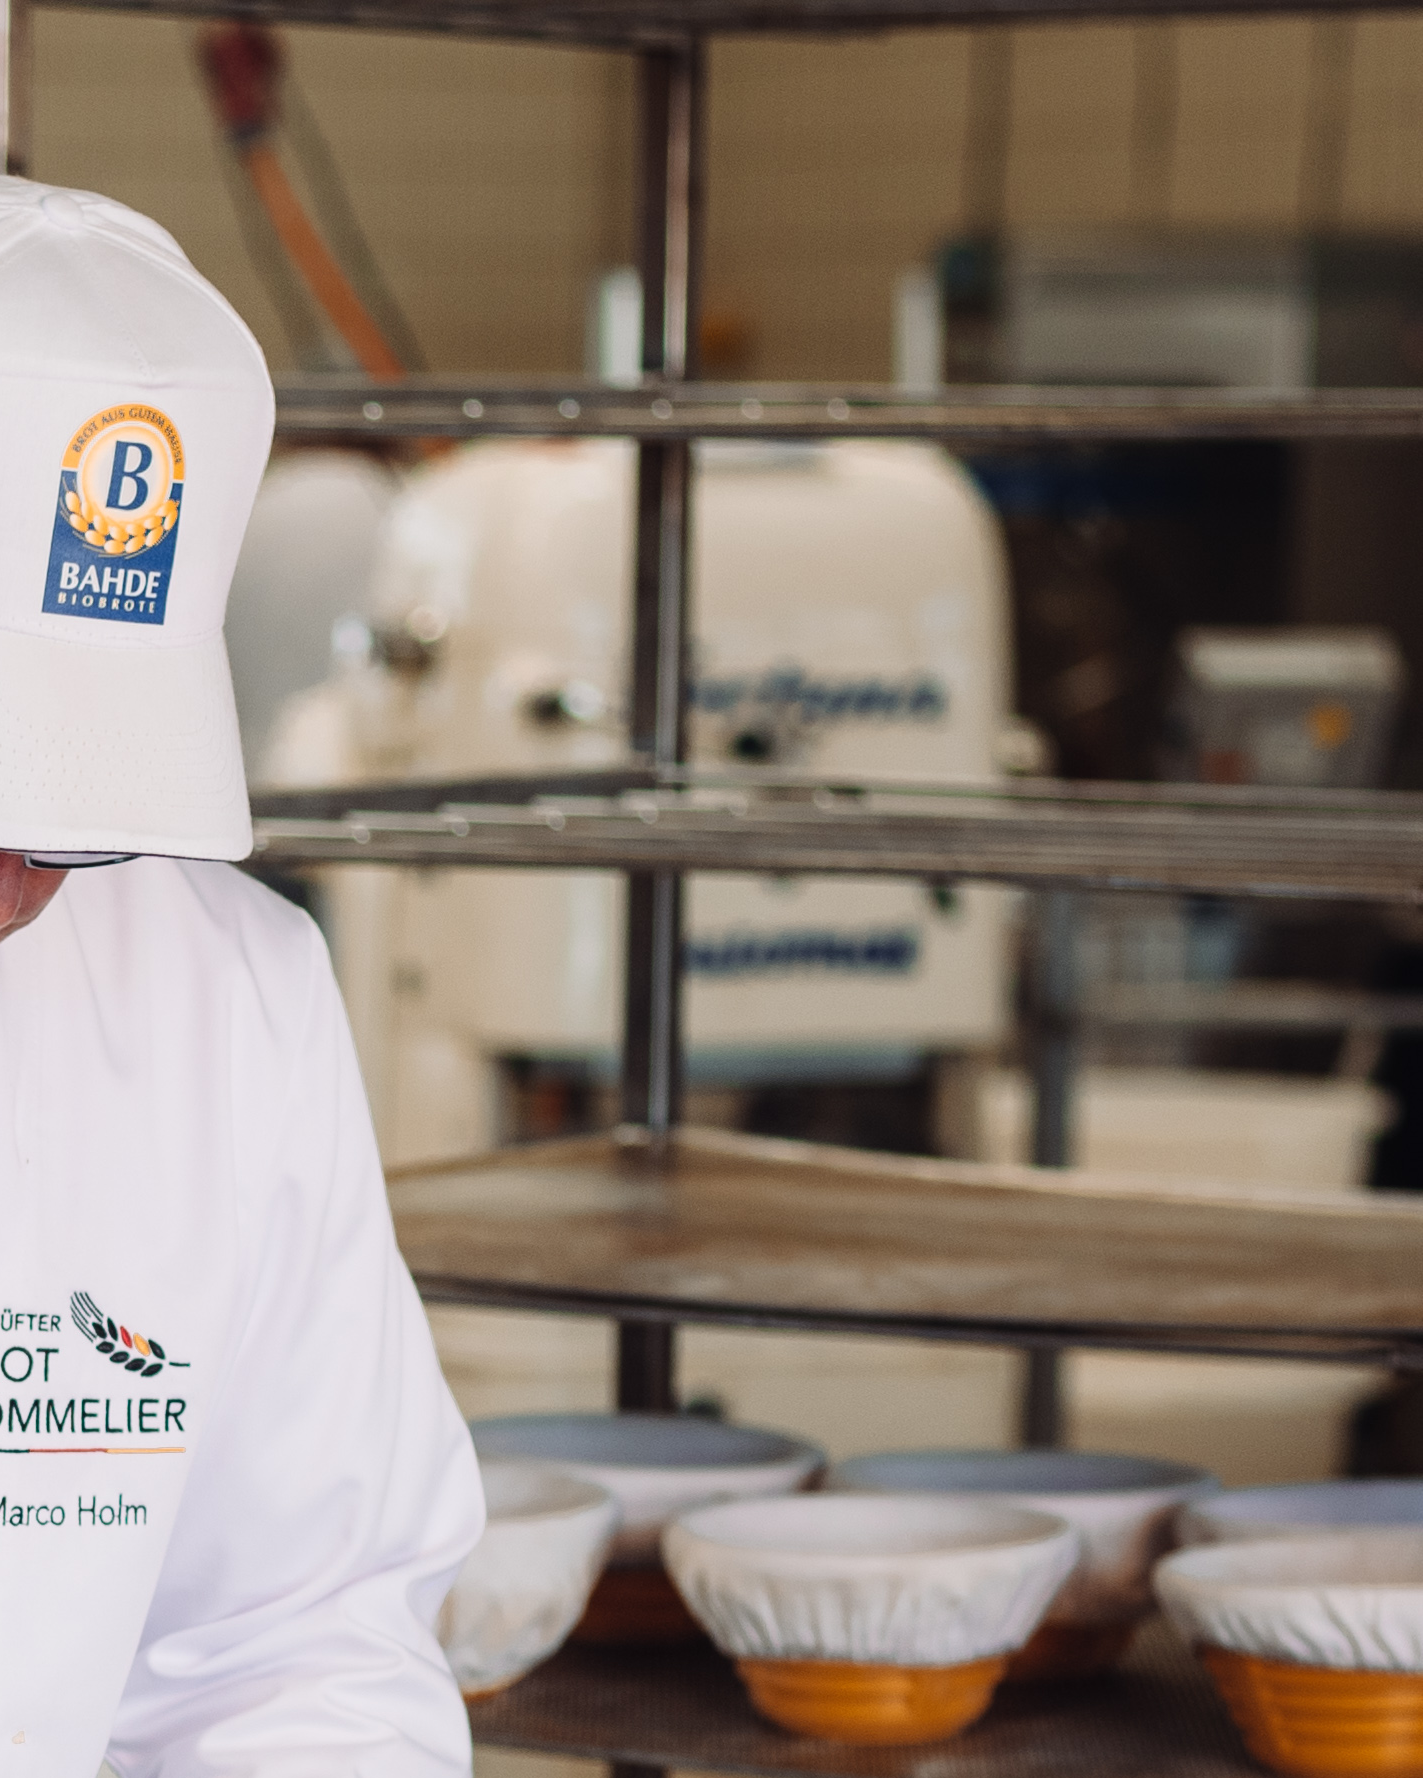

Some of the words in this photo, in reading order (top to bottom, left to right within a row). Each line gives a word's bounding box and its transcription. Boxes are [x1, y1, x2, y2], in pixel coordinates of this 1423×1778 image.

[72, 423, 98, 453] BROT
[102, 409, 125, 425] AUS
[129, 407, 165, 427] GUTEM
[106, 440, 153, 511] B
[60, 562, 161, 598] BAHDE
[58, 593, 156, 613] BIOBROTE
[78, 1494, 147, 1526] Holm
